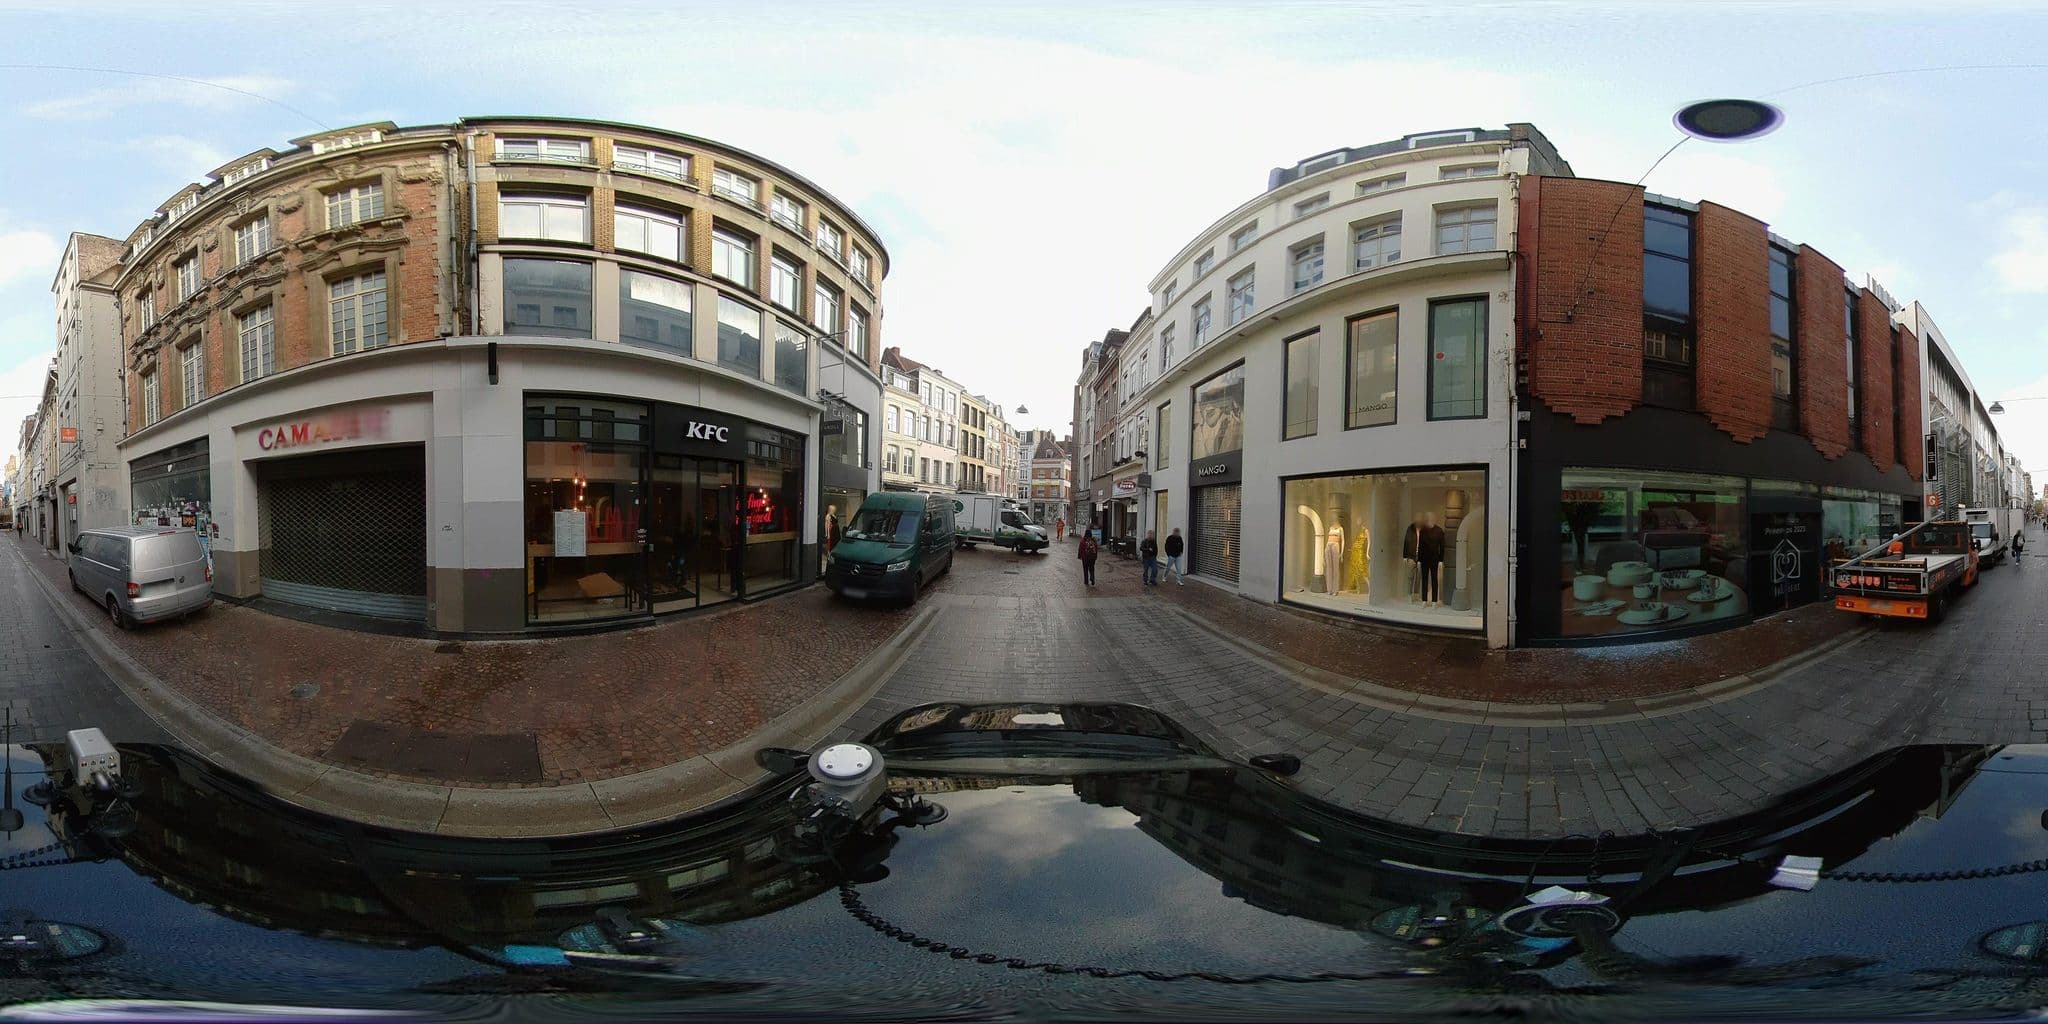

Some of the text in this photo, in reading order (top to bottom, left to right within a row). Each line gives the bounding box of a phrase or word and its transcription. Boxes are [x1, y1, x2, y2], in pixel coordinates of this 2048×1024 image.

[1359, 403, 1388, 413] MANGO
[686, 421, 729, 443] KFC
[1198, 464, 1226, 477] MANGO
